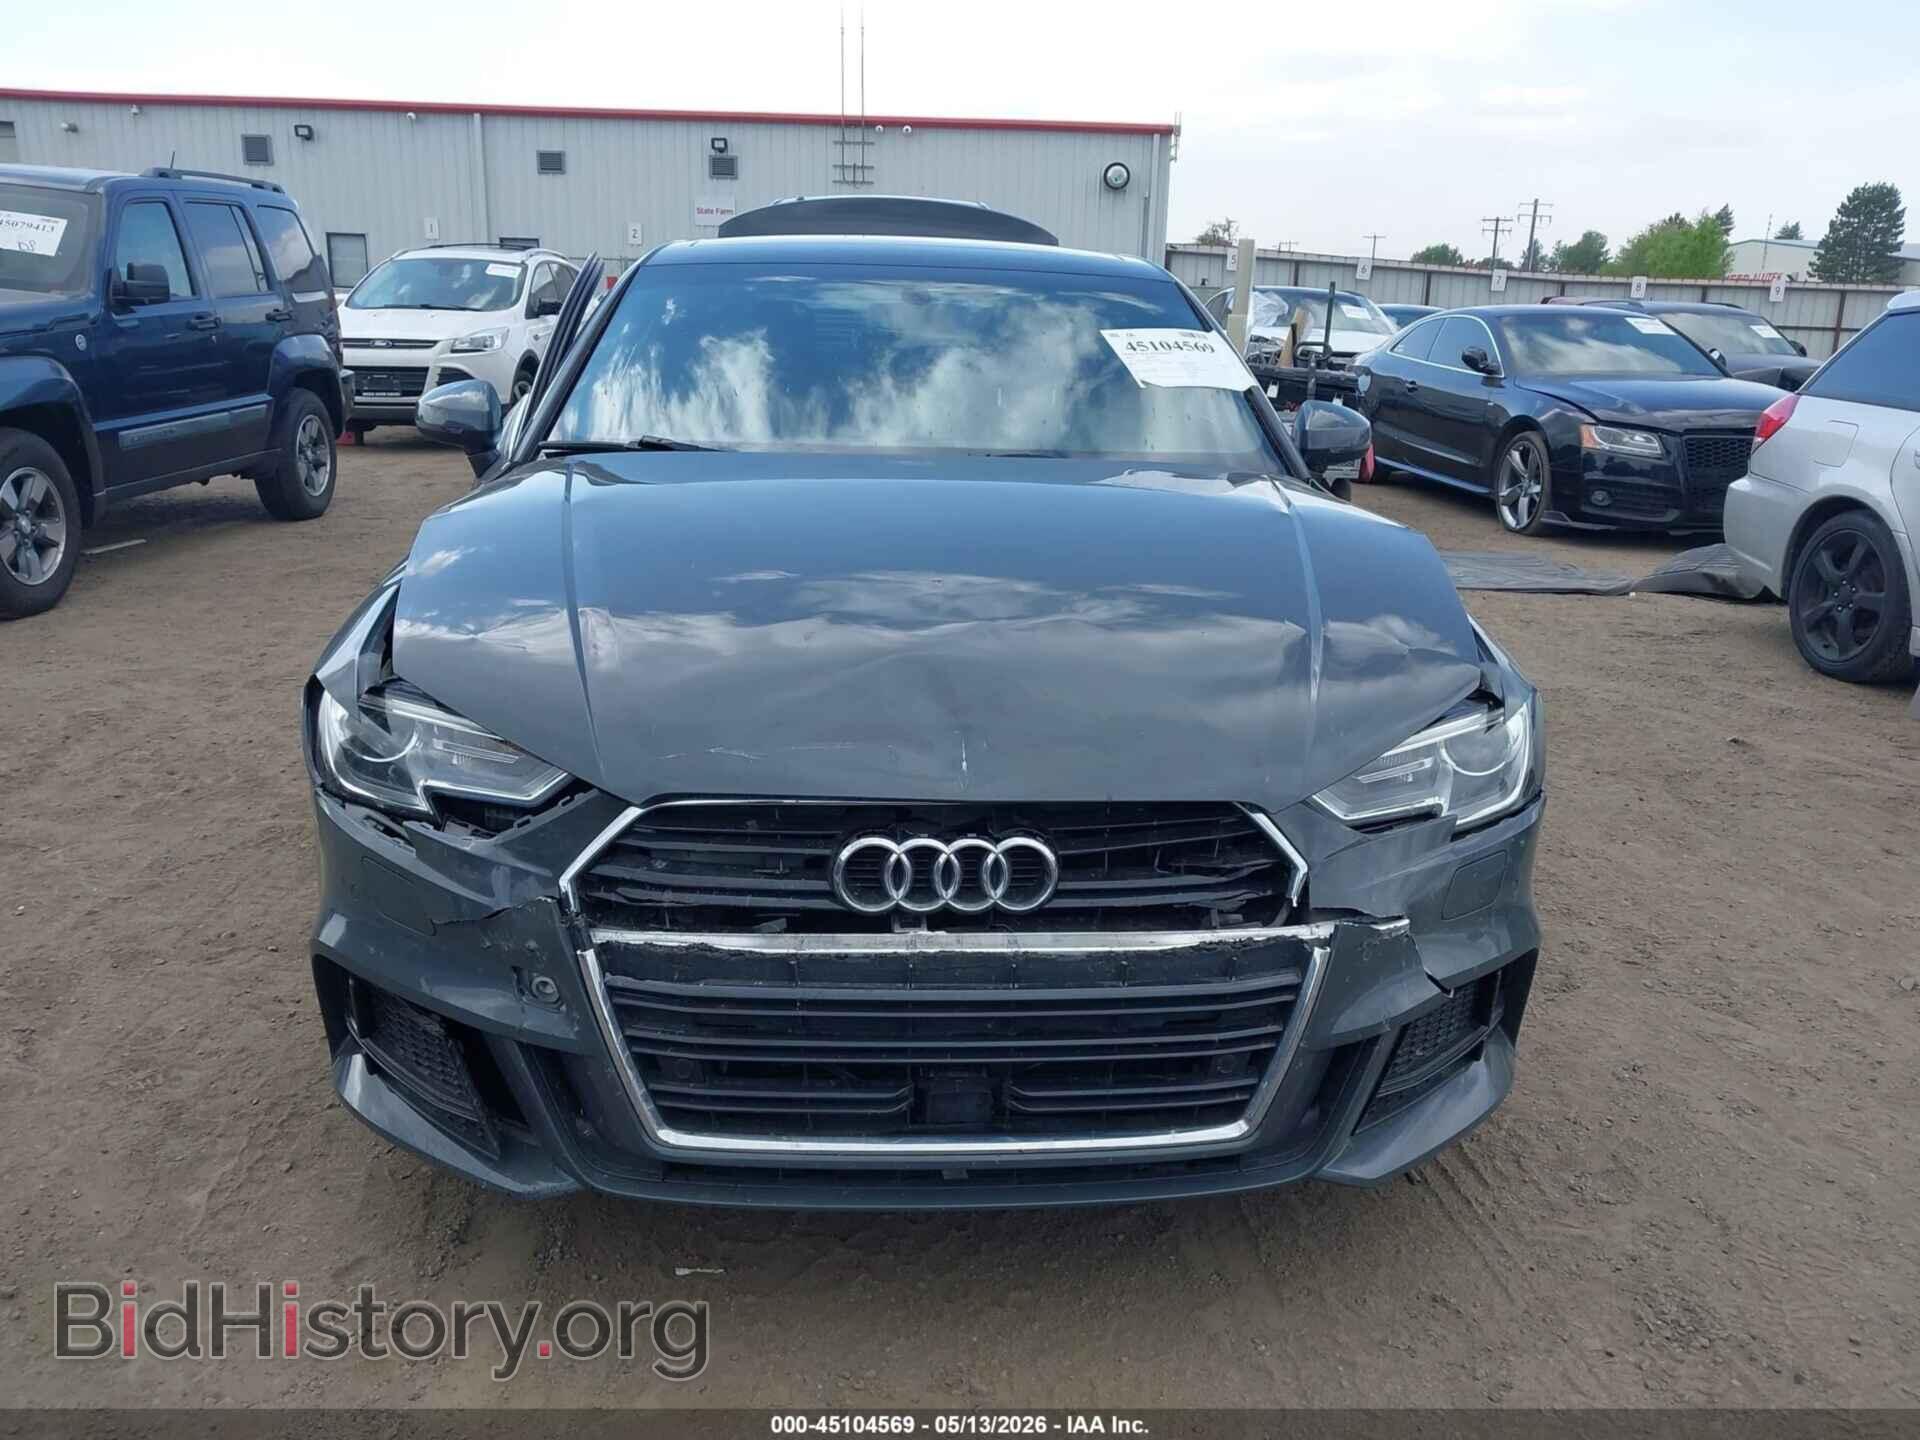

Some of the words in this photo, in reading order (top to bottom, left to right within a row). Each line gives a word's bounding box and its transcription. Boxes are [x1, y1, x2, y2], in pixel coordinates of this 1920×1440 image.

[715, 207, 734, 215] Farm
[631, 228, 640, 239] 2
[1230, 254, 1237, 265] 5
[1360, 264, 1368, 274] 6
[1495, 275, 1502, 284] 7
[1635, 281, 1642, 291] 8
[1775, 286, 1781, 296] 9
[1126, 340, 1215, 354] 45104569
